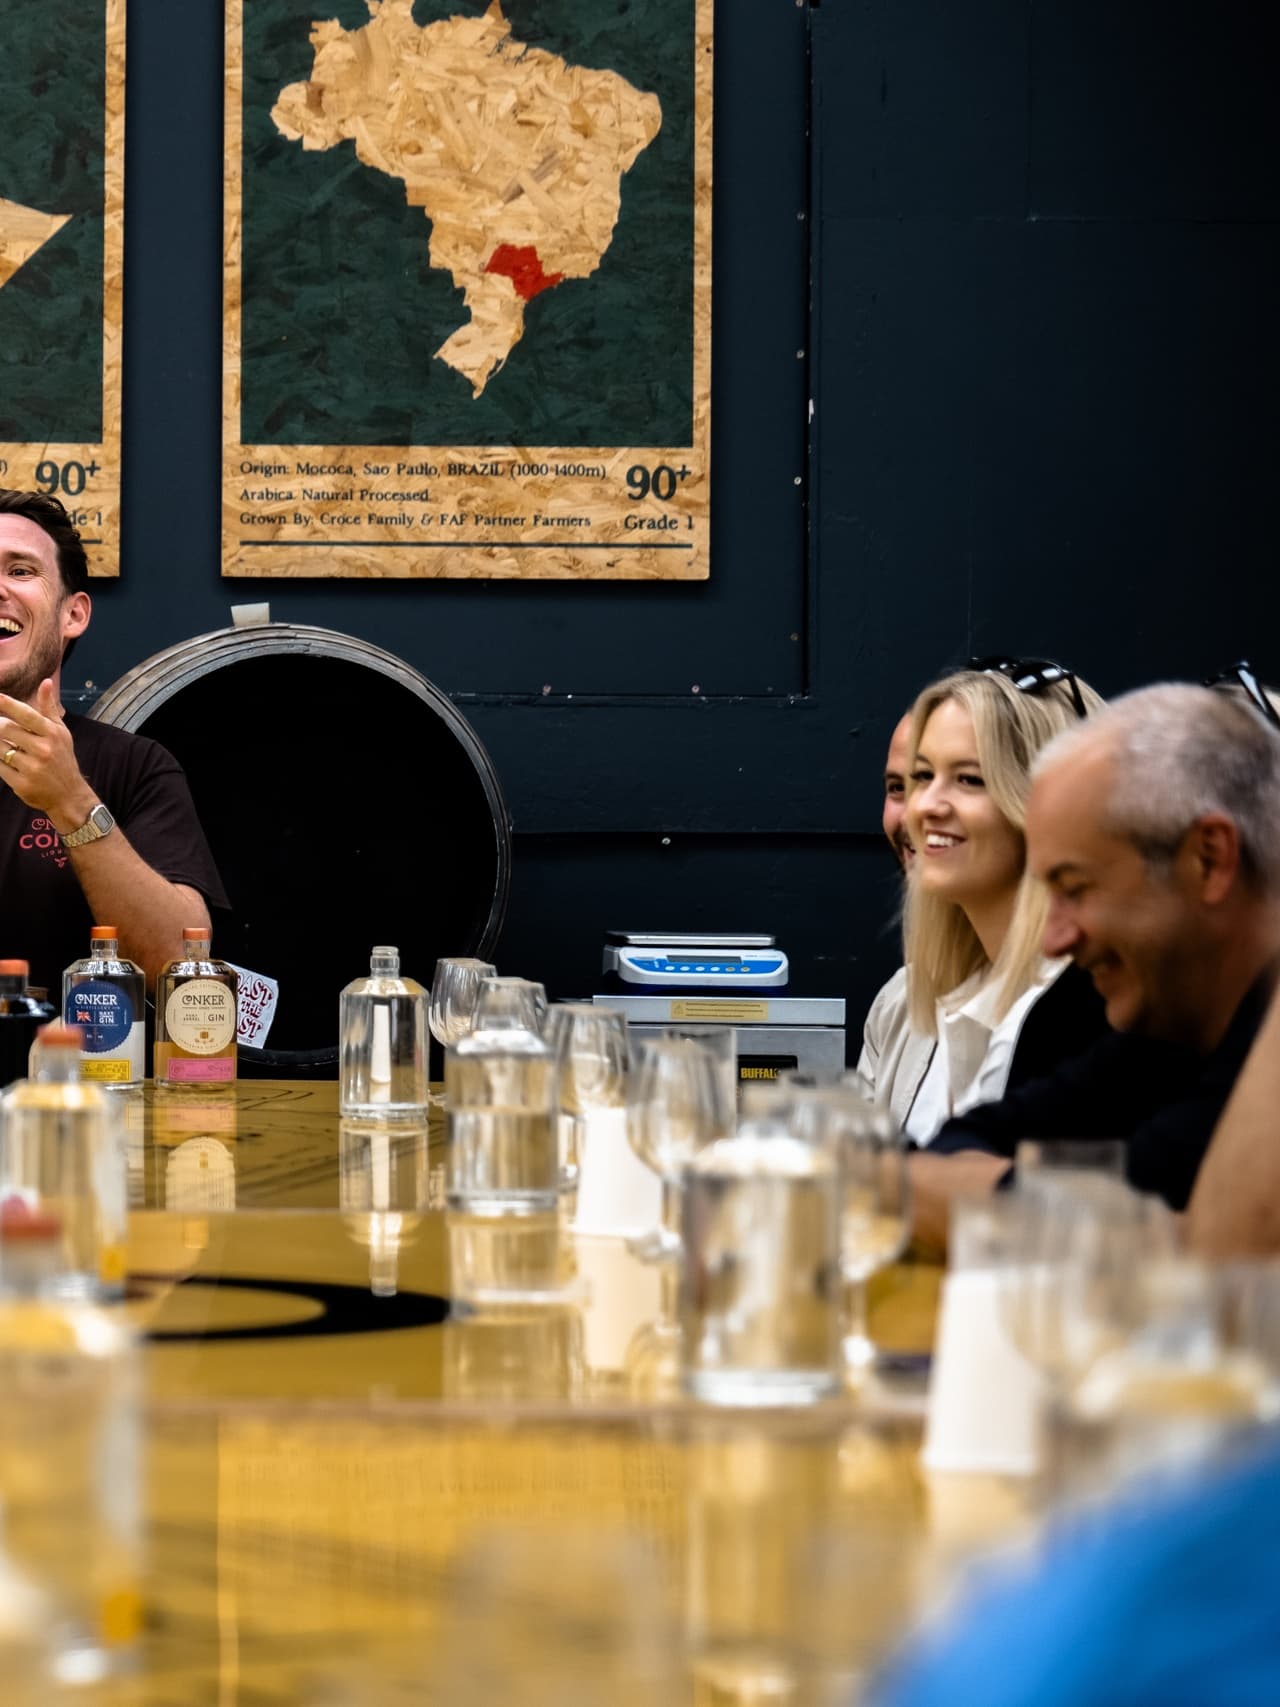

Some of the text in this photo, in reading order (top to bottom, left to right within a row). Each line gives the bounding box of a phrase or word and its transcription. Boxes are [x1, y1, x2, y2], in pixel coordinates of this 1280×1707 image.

[240, 461, 290, 477] Origin:
[297, 463, 357, 477] Mococa,
[363, 463, 390, 476] Sao
[397, 463, 441, 478] Paulo,
[448, 463, 504, 476] BRAZIL
[302, 488, 353, 501] Natural
[239, 512, 287, 525] Grown
[320, 512, 361, 526] Croce
[368, 513, 414, 528] Family
[421, 513, 433, 526] &
[440, 514, 467, 526] FAF
[475, 514, 526, 528] Partner
[533, 514, 591, 527] Farmers
[624, 514, 678, 530] Grade
[74, 993, 118, 1006] CONKER
[181, 994, 225, 1006] CONKER
[207, 1013, 225, 1022] GIN
[740, 1067, 777, 1079] BUFFAL
